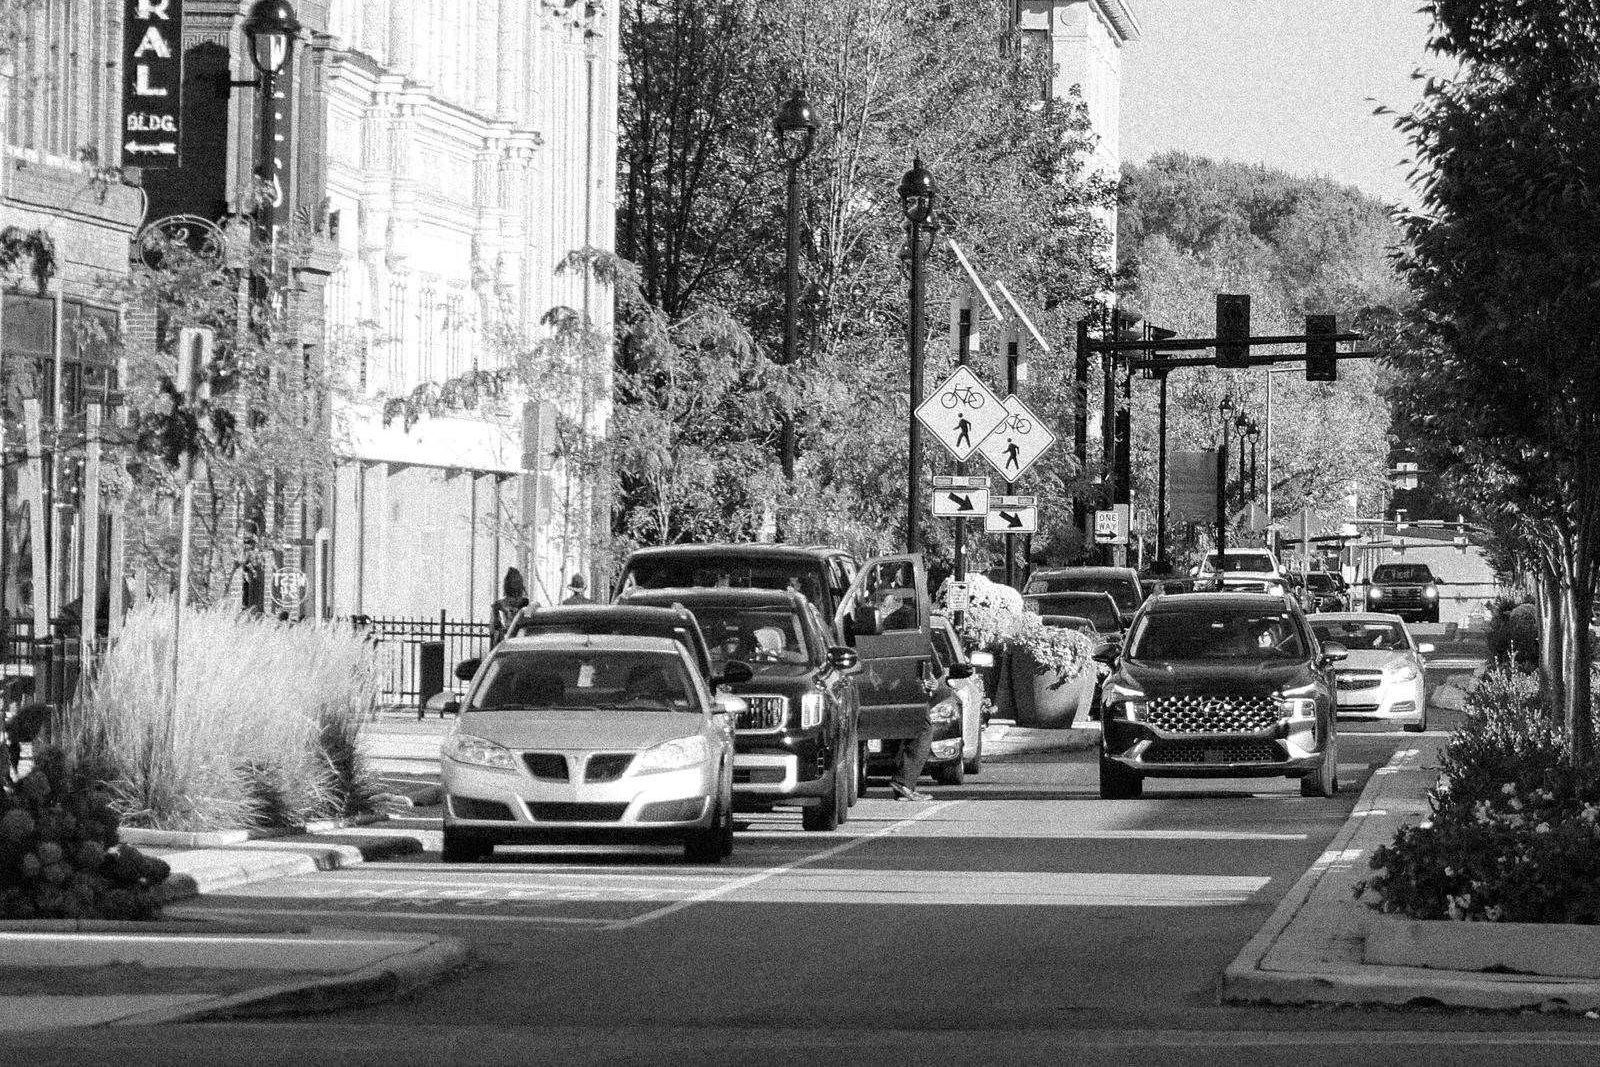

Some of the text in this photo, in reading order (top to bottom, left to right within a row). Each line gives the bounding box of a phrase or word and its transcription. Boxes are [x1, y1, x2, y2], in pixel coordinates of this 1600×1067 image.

[126, 114, 178, 132] BLDG.
[1100, 514, 1116, 522] ONE
[1100, 522, 1116, 530] WAY
